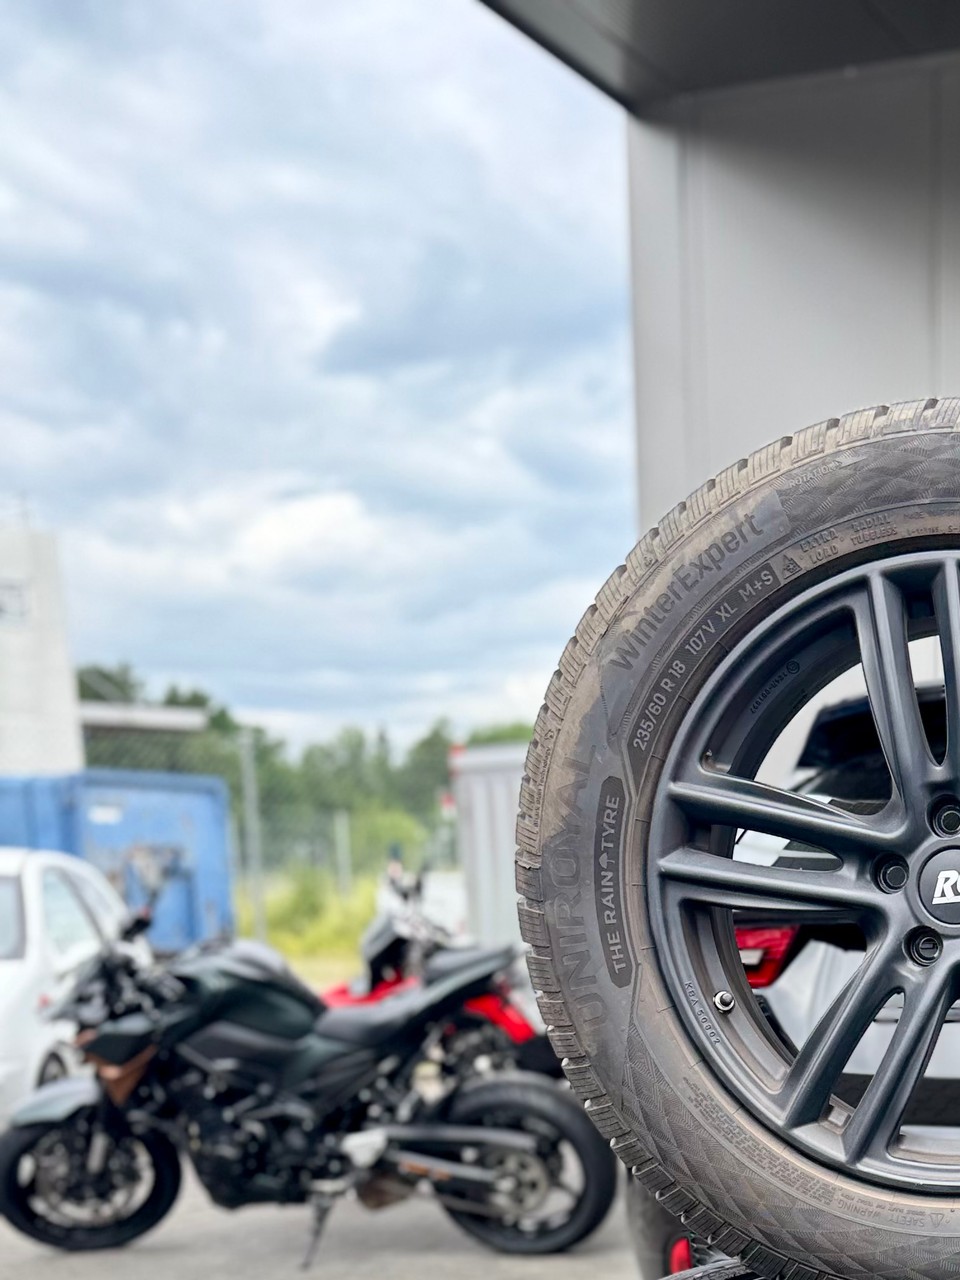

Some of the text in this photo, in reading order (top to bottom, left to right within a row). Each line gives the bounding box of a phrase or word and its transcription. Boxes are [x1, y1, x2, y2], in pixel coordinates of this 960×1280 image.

[788, 459, 840, 487] ROTATION
[852, 514, 891, 532] RADIAL
[800, 528, 838, 553] EXTRA
[851, 527, 897, 546] TUBELESS
[810, 544, 838, 566] LOAD
[610, 513, 763, 671] WinterExpert
[633, 570, 774, 751] 235/60 R 18 107V XL M+S
[549, 743, 608, 1030] UNIROYAL
[601, 795, 627, 974] THE RAIN TYRE
[684, 981, 698, 1007] KBA
[835, 1199, 881, 1219] WARNING
[888, 1213, 924, 1227] SAFETY
